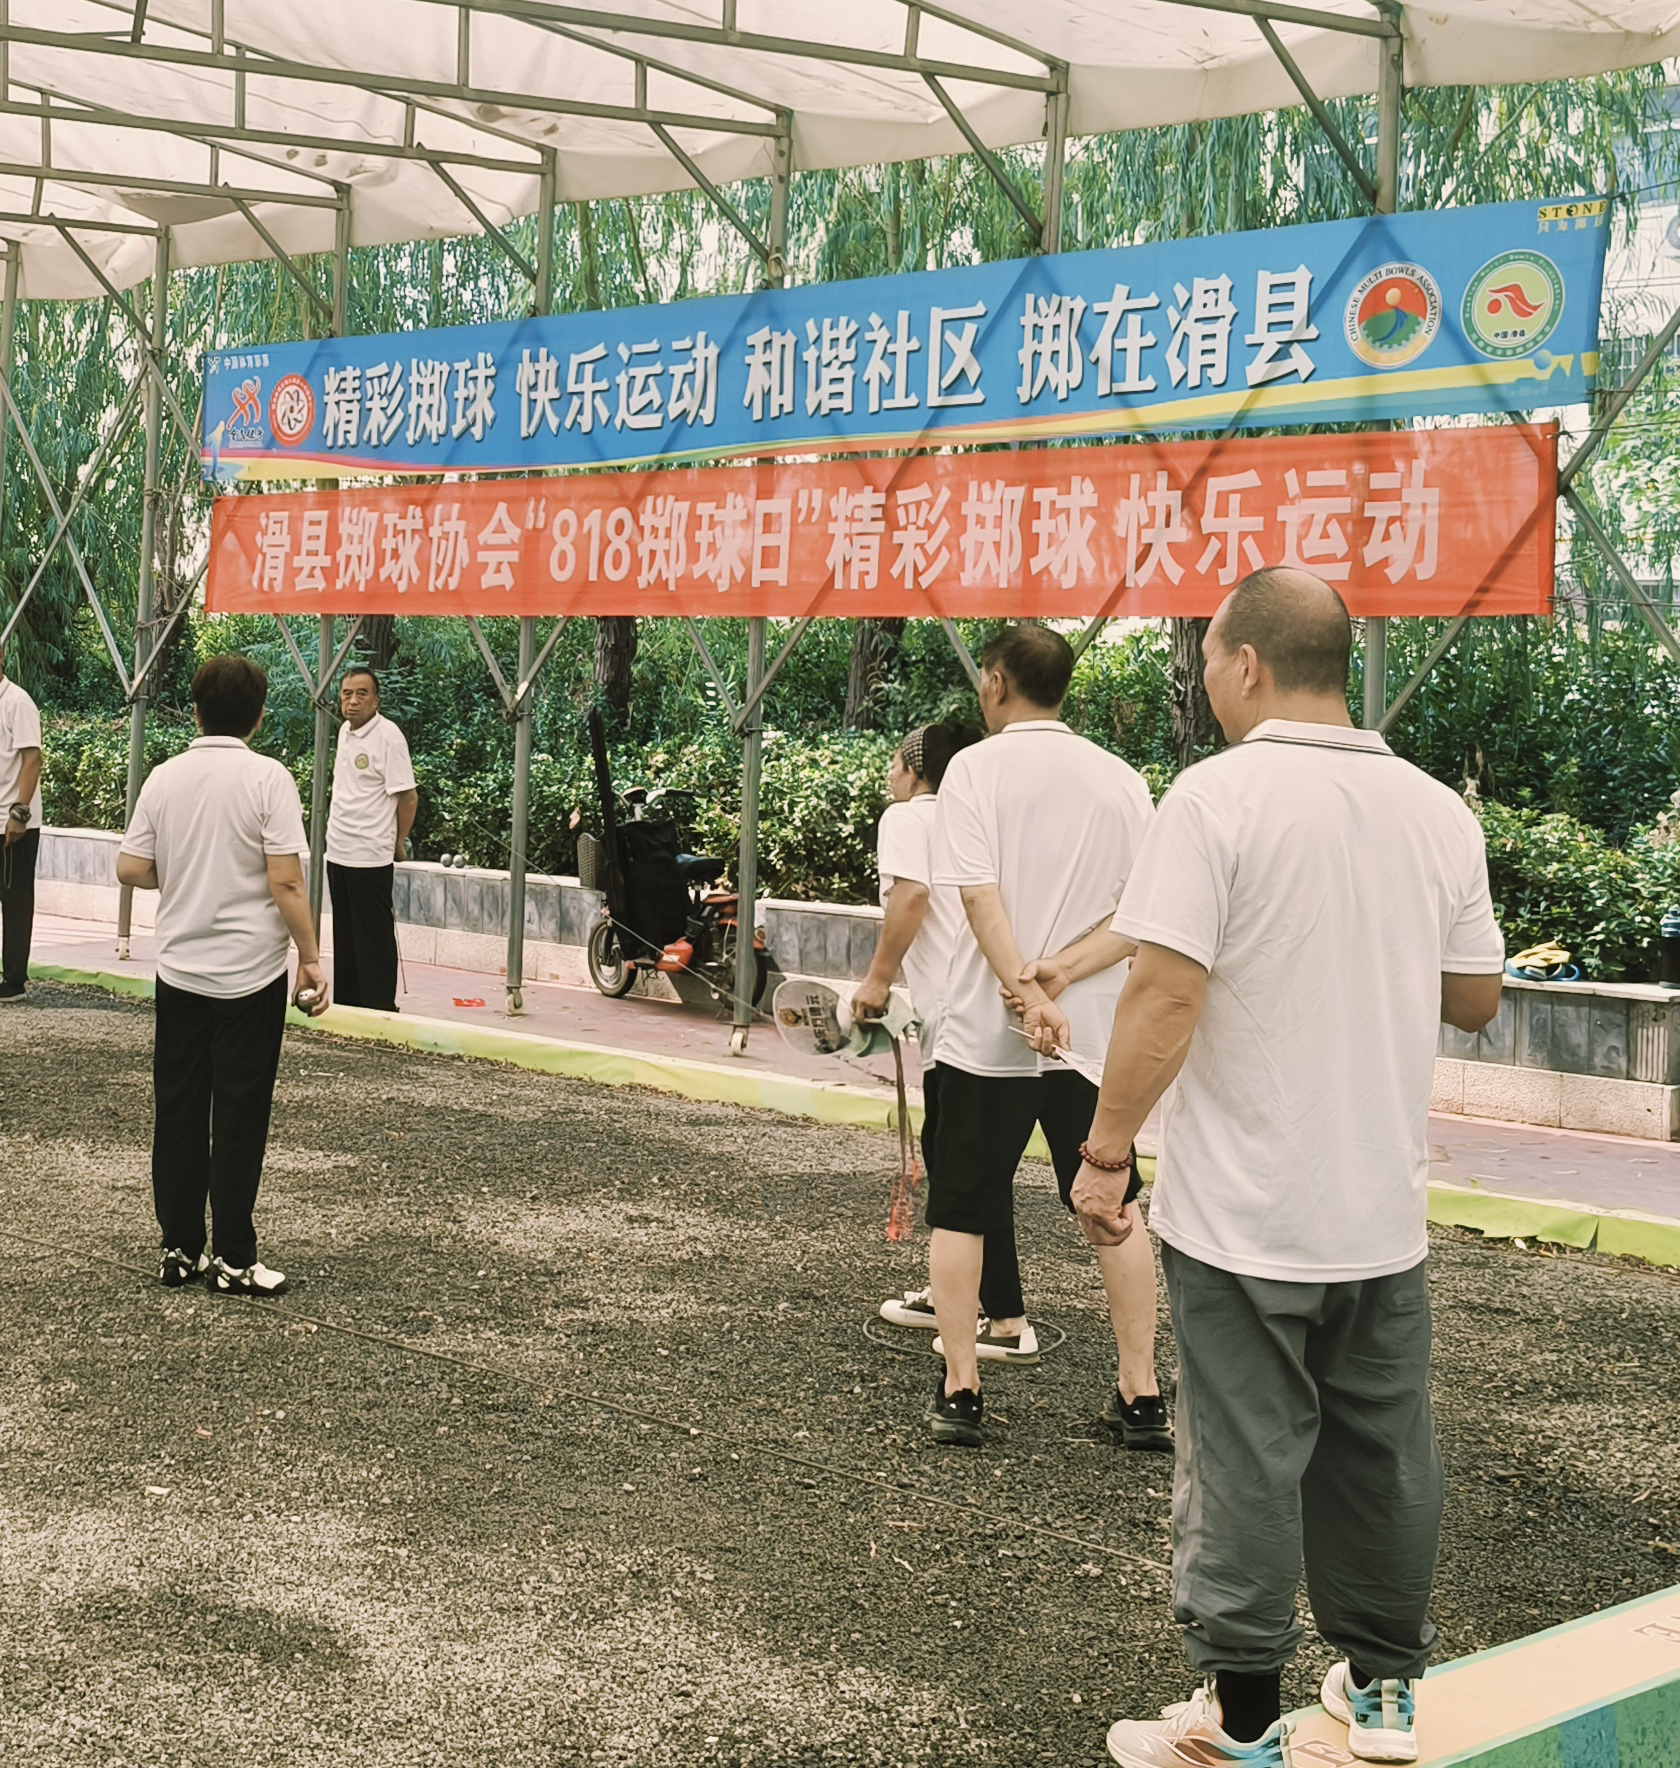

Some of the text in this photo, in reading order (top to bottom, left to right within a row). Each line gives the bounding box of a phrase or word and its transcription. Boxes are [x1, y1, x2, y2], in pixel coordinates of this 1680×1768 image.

[322, 263, 1320, 449] 精彩掷球 快乐运动 和谐社区 掷在滑县
[1348, 297, 1361, 342] CHINESE
[1357, 270, 1383, 295] MULTI
[1385, 266, 1417, 277] BOWLS
[1416, 275, 1438, 336] ASSOCIATION
